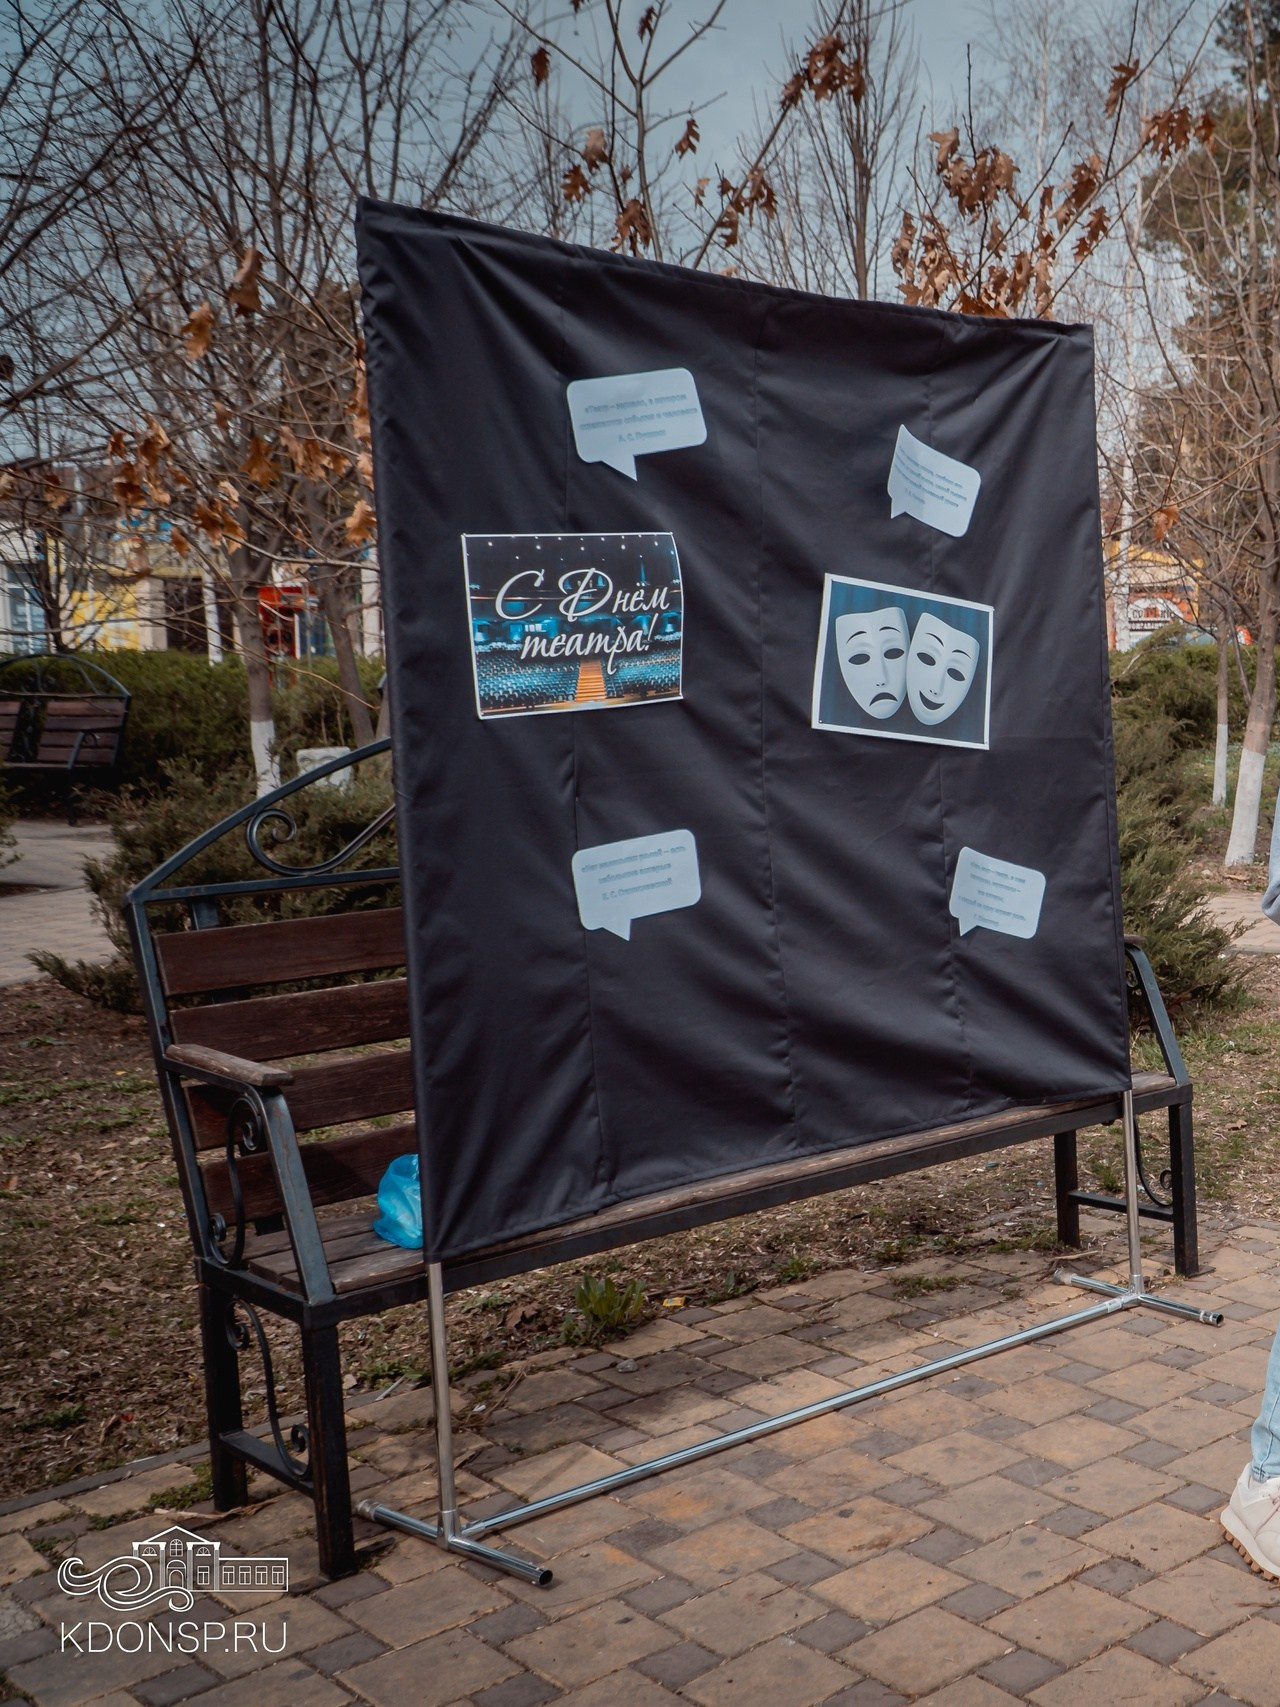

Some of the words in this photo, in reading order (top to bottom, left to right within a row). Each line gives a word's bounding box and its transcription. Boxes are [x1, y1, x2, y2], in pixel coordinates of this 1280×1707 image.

[495, 569, 545, 620] С
[558, 567, 671, 622] Днём
[520, 613, 659, 675] театра!
